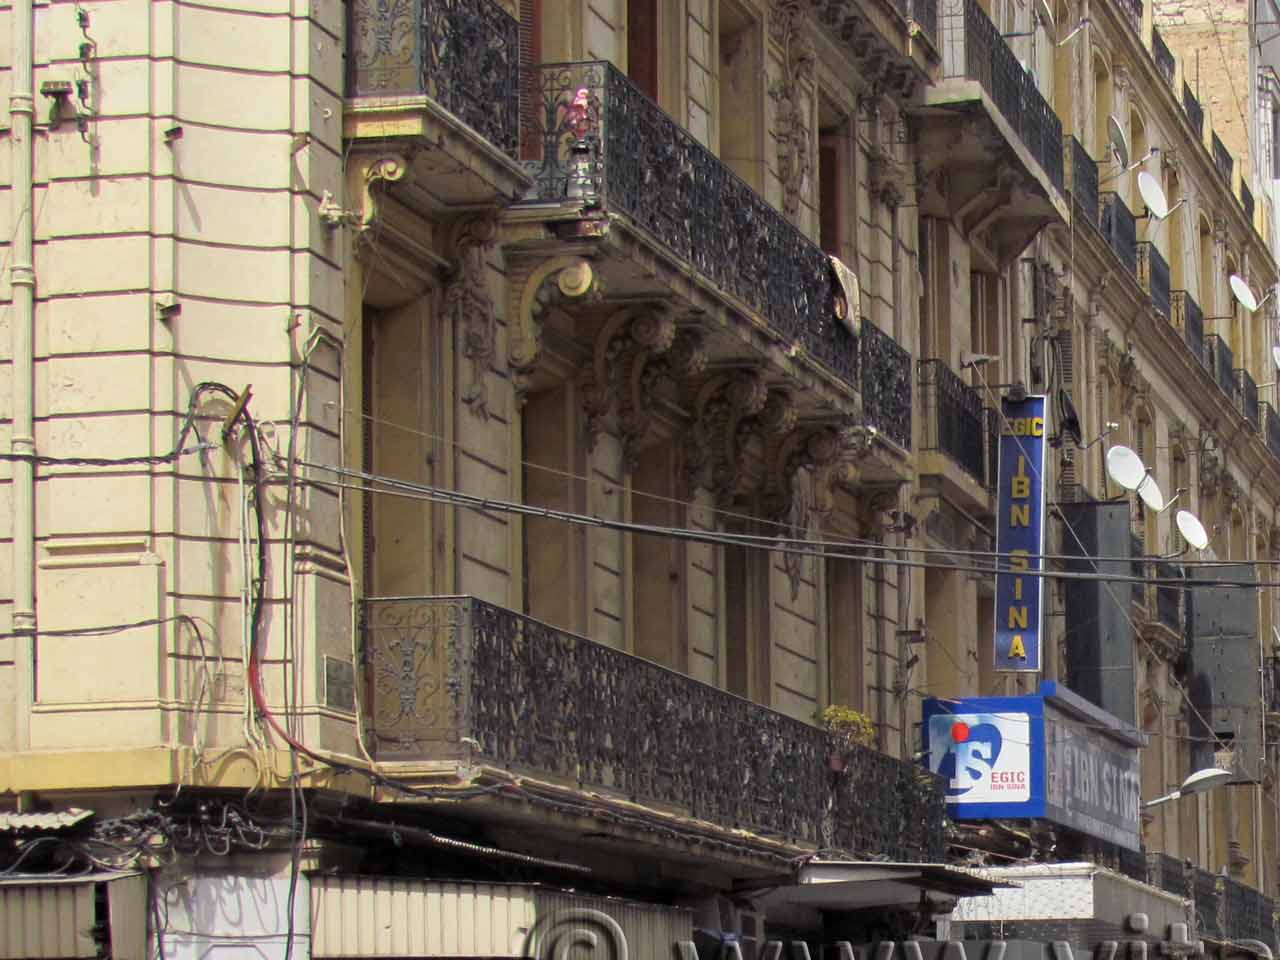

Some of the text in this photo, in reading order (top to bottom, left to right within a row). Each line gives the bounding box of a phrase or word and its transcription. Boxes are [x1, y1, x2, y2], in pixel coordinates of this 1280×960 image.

[1001, 417, 1044, 437] EGIC
[1011, 455, 1031, 527] IBN
[1007, 549, 1031, 658] SINA
[991, 771, 1025, 783] EGIC
[991, 783, 1026, 791] IBN SINA
[1102, 760, 1138, 823] SINA
